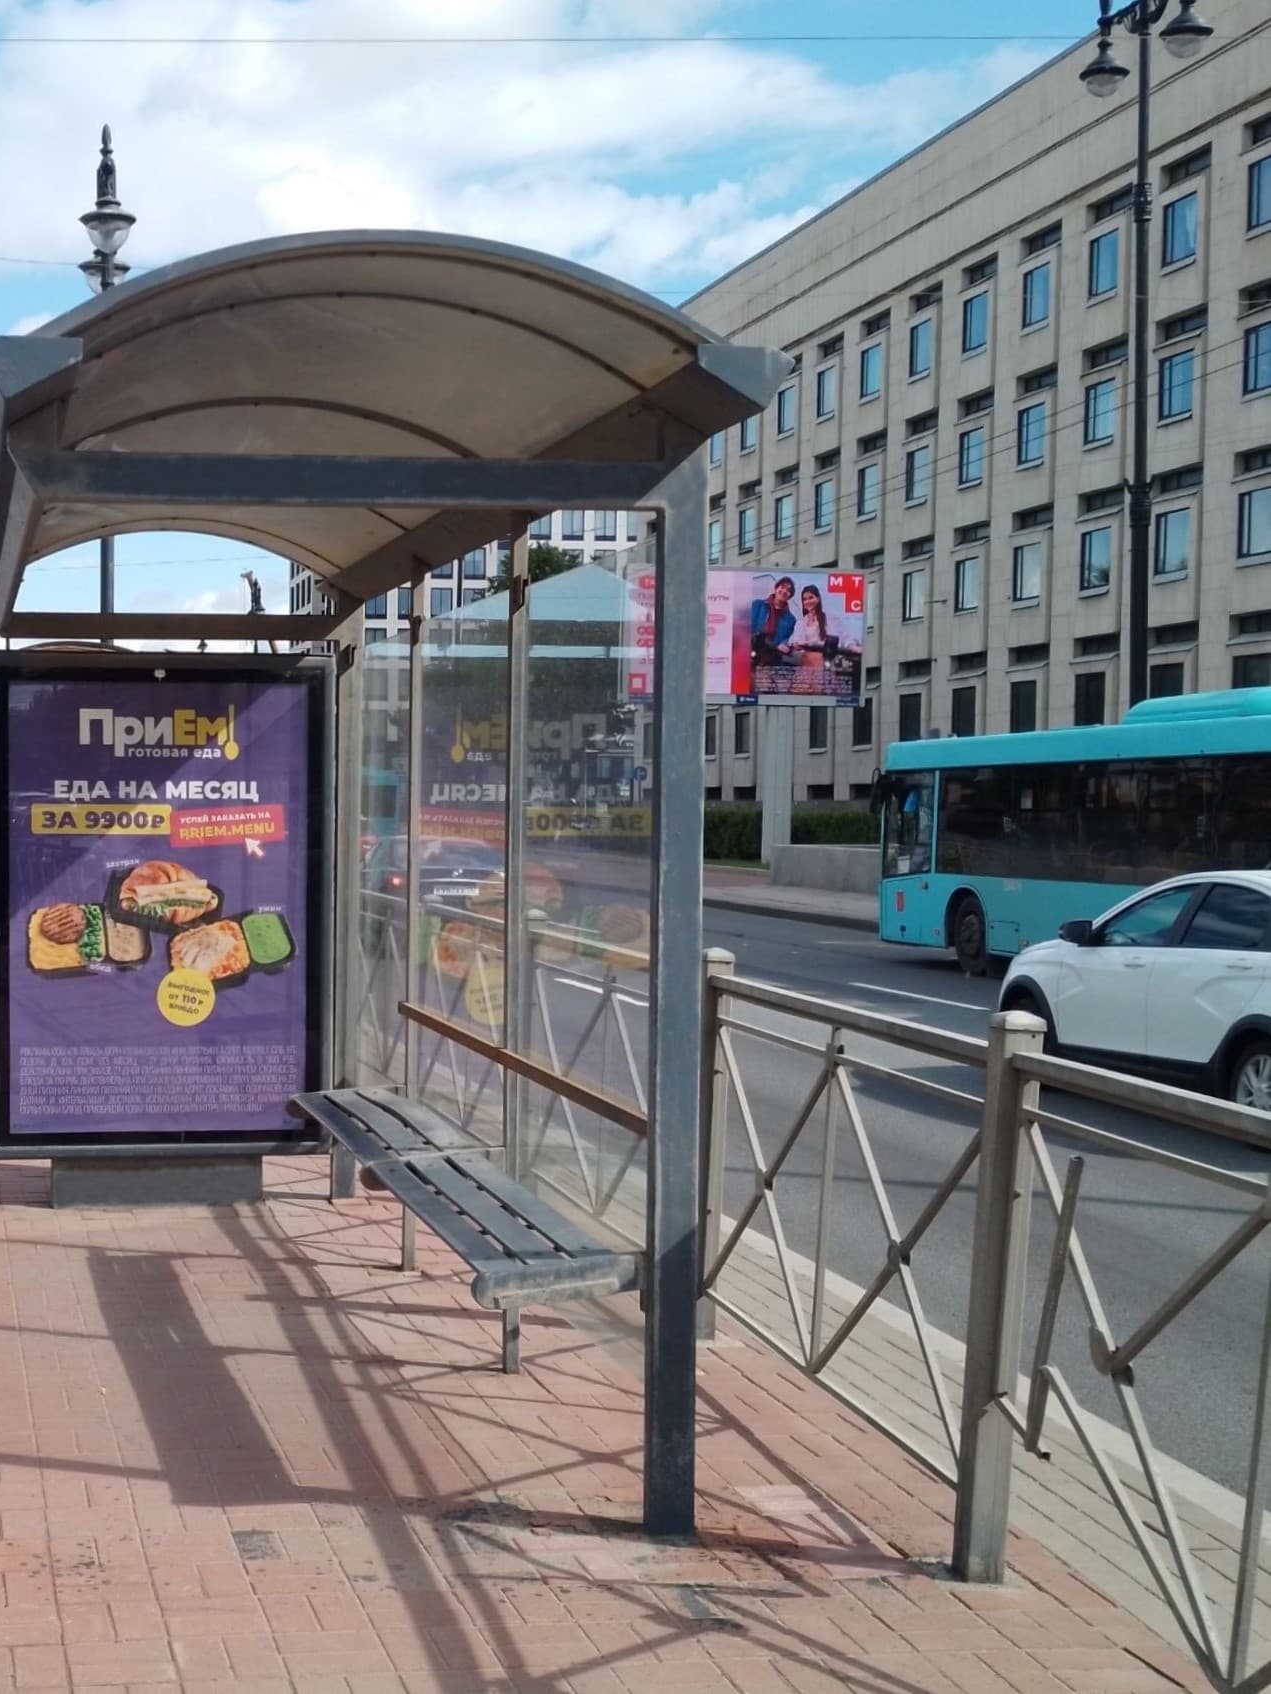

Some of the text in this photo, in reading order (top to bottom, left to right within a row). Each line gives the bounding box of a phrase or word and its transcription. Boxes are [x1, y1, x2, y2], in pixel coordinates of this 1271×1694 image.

[128, 748, 221, 759] готовая еда
[54, 780, 259, 803] ЕДА НА МЕСЯЦ
[42, 811, 77, 829] ЗА
[180, 814, 209, 824] УСПЕЙ
[258, 811, 271, 819] НА
